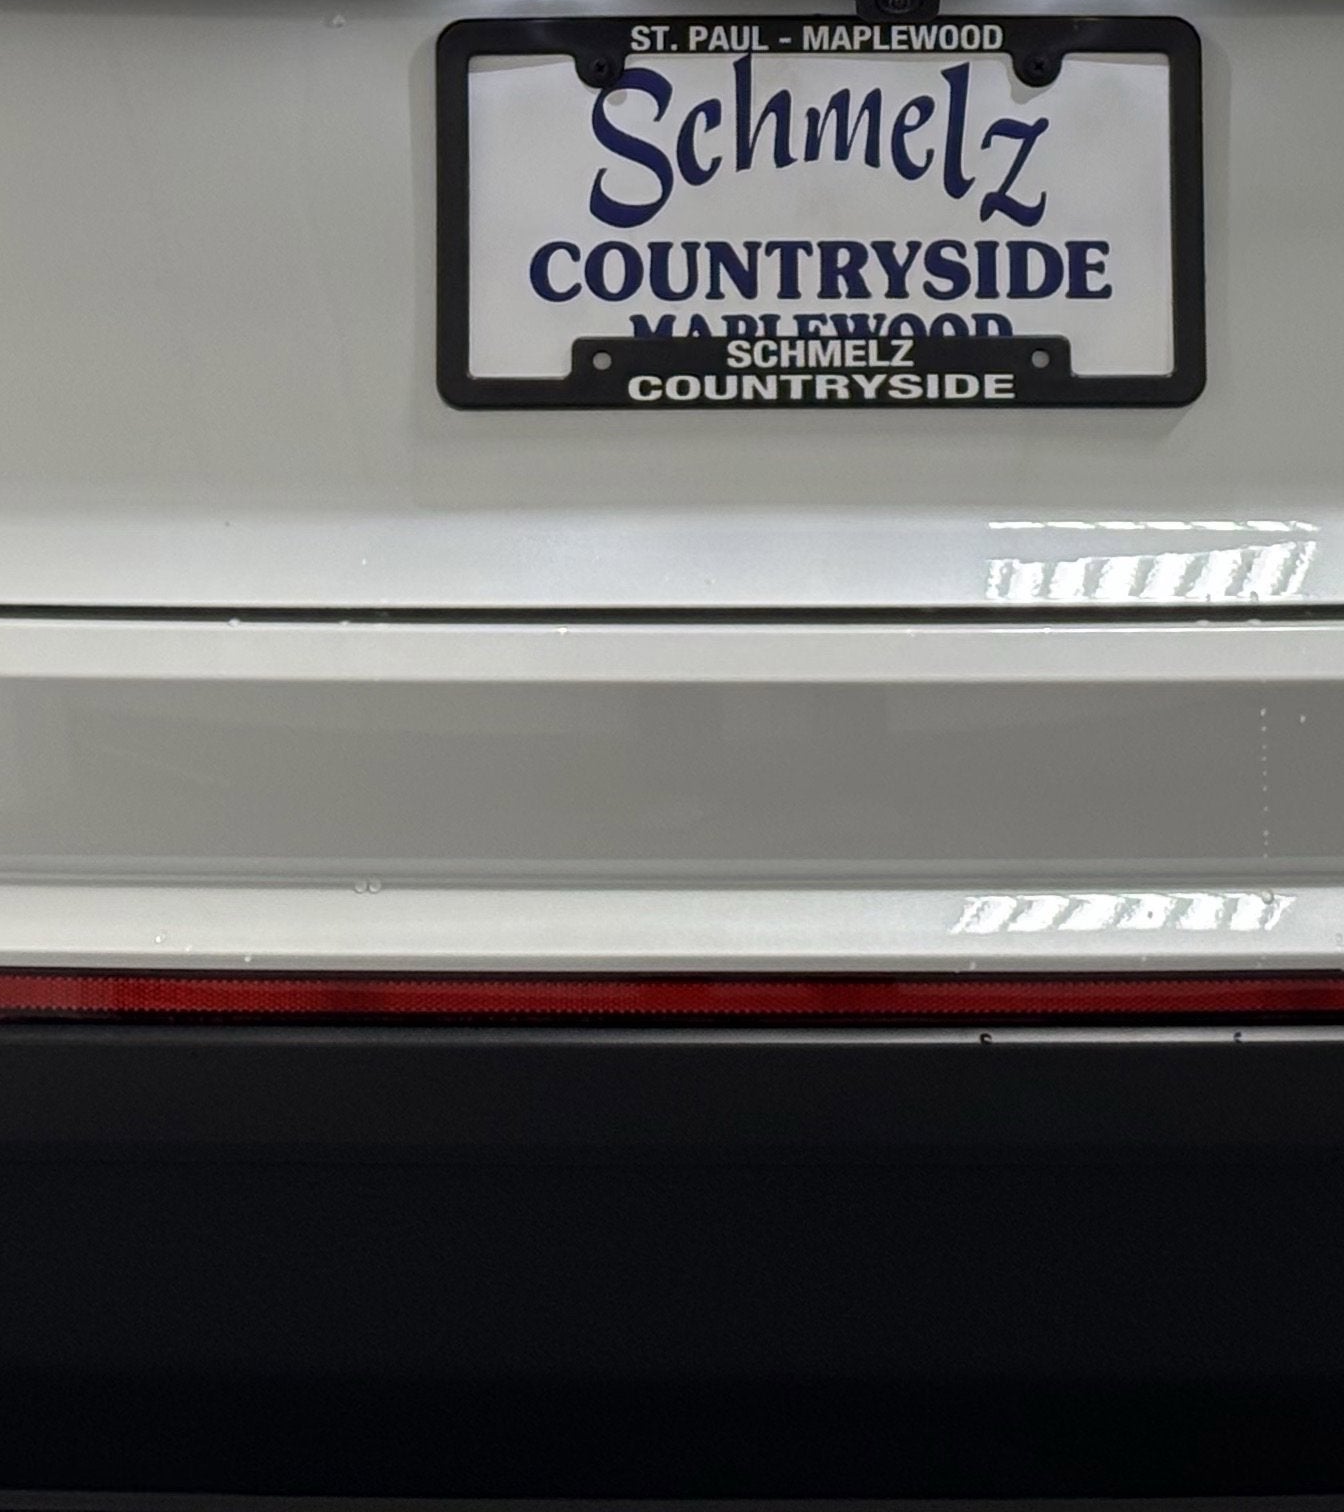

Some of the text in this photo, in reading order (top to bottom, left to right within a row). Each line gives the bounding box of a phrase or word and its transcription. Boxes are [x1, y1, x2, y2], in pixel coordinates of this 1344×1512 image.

[630, 24, 678, 52] ST.
[688, 24, 770, 52] PAUL
[801, 24, 1005, 52] MAPLEWOOD
[588, 53, 1050, 229] Schmelz
[528, 239, 1114, 303] COUNTRYSIDE
[726, 339, 915, 369] SCHMELZ
[627, 373, 1017, 402] COUNTRYSIDE
